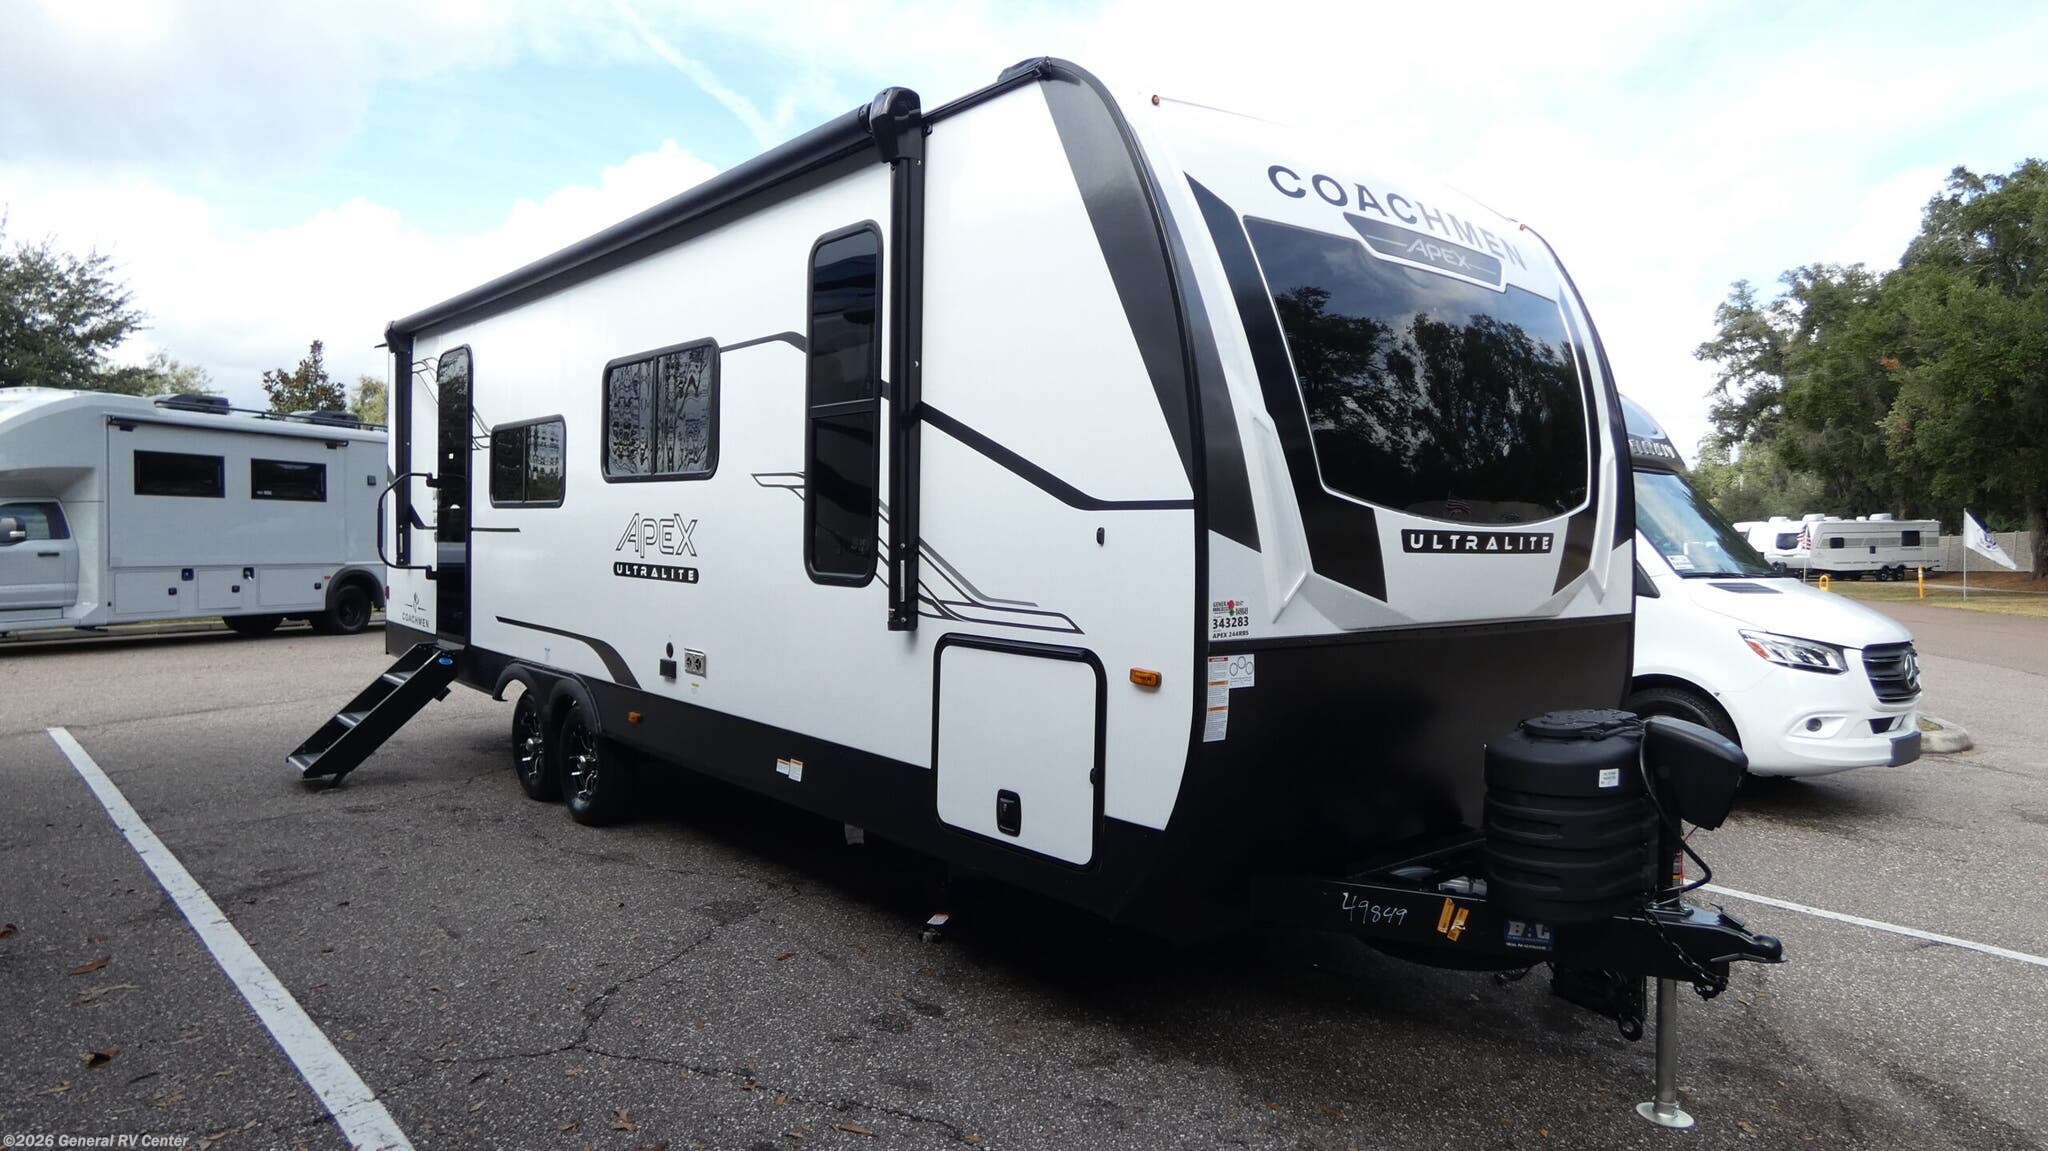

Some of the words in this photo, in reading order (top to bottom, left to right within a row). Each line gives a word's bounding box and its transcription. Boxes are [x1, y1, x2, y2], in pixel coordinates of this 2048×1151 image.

[1267, 164, 1528, 271] COACHMEN
[1405, 239, 1471, 270] APEX
[615, 512, 698, 558] APEX
[1410, 533, 1551, 552] ULTRALITE
[616, 564, 695, 581] ULTRALITE
[401, 612, 430, 628] COACHMEN
[1212, 616, 1249, 629] 343283
[1342, 892, 1408, 926] 49849
